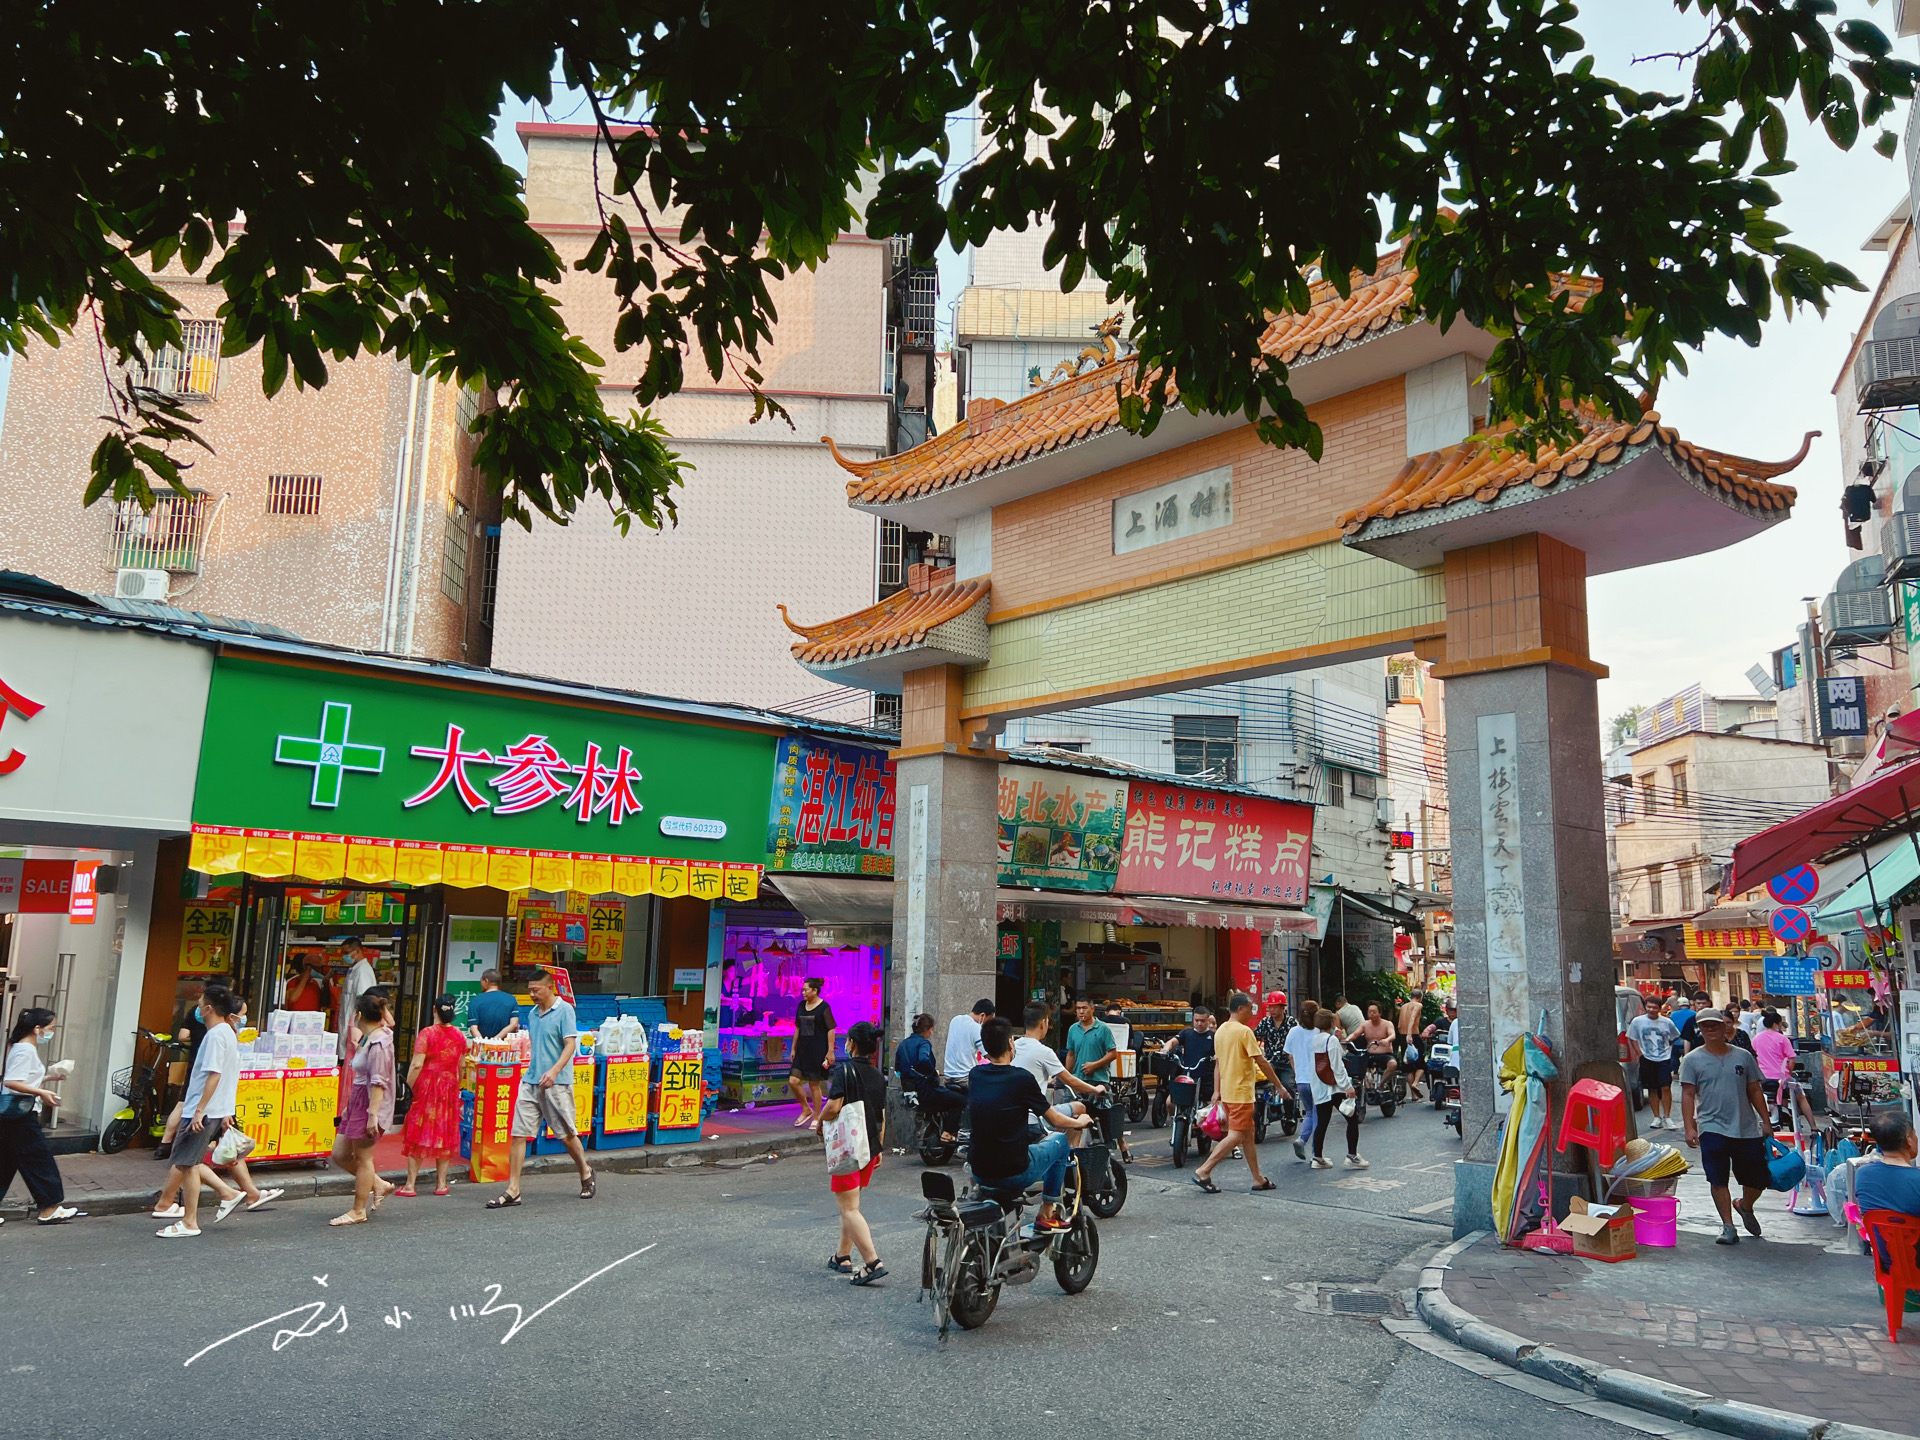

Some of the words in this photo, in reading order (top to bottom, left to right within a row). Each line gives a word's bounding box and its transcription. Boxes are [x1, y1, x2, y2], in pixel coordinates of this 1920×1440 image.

[1125, 487, 1217, 538] 上涌村
[1827, 678, 1861, 731] 网咖
[403, 722, 643, 825] 大参林
[783, 746, 799, 797] 肉质有弹性
[998, 777, 1107, 829] 湖北水产
[1133, 789, 1157, 807] 绿色
[1164, 792, 1187, 811] 健康
[1193, 794, 1217, 816] 新鲜
[1222, 800, 1245, 819] 美味
[773, 805, 792, 869] 熟肉口感劲道
[1120, 808, 1309, 878] 熊记糕点
[791, 852, 823, 871] 绿色生态
[860, 855, 894, 874] 联系电话
[25, 879, 70, 894] SALE
[1211, 880, 1255, 898] 现烤现卖
[1261, 884, 1303, 902] 欢迎品尝
[186, 908, 234, 937] 全场
[543, 922, 559, 938] 送
[590, 908, 623, 932] 全场
[997, 932, 1019, 958] 虾
[1832, 974, 1865, 986] 手撕鸡
[608, 1056, 628, 1064] 今周特价
[287, 1071, 312, 1079] 今周特价
[663, 1061, 701, 1091] 全场
[494, 1085, 510, 1143] 欢迎取阅
[304, 1131, 322, 1153] 4
